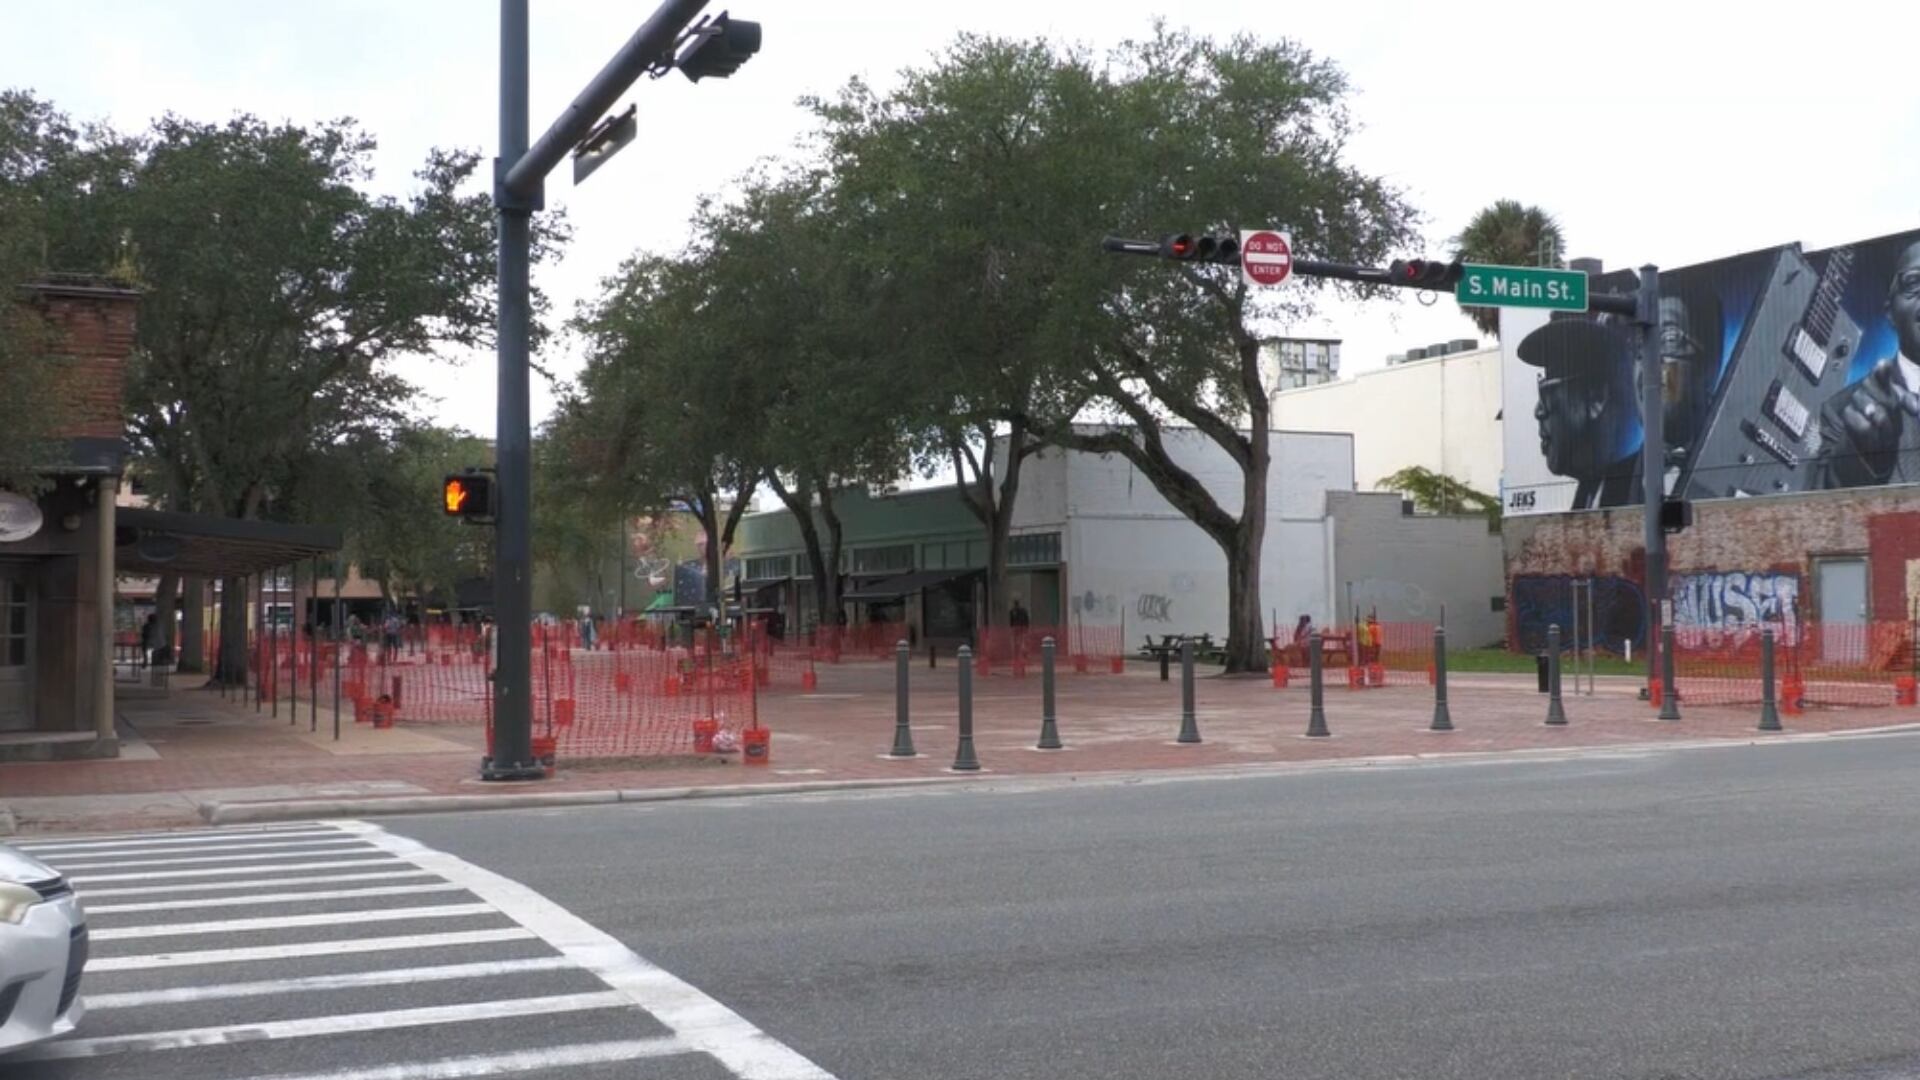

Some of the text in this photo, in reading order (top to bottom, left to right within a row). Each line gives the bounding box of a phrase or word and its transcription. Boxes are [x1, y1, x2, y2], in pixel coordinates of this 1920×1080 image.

[1249, 241, 1284, 252] DO NOT
[1253, 265, 1281, 275] ENTER
[1469, 275, 1576, 300] S. Main St.
